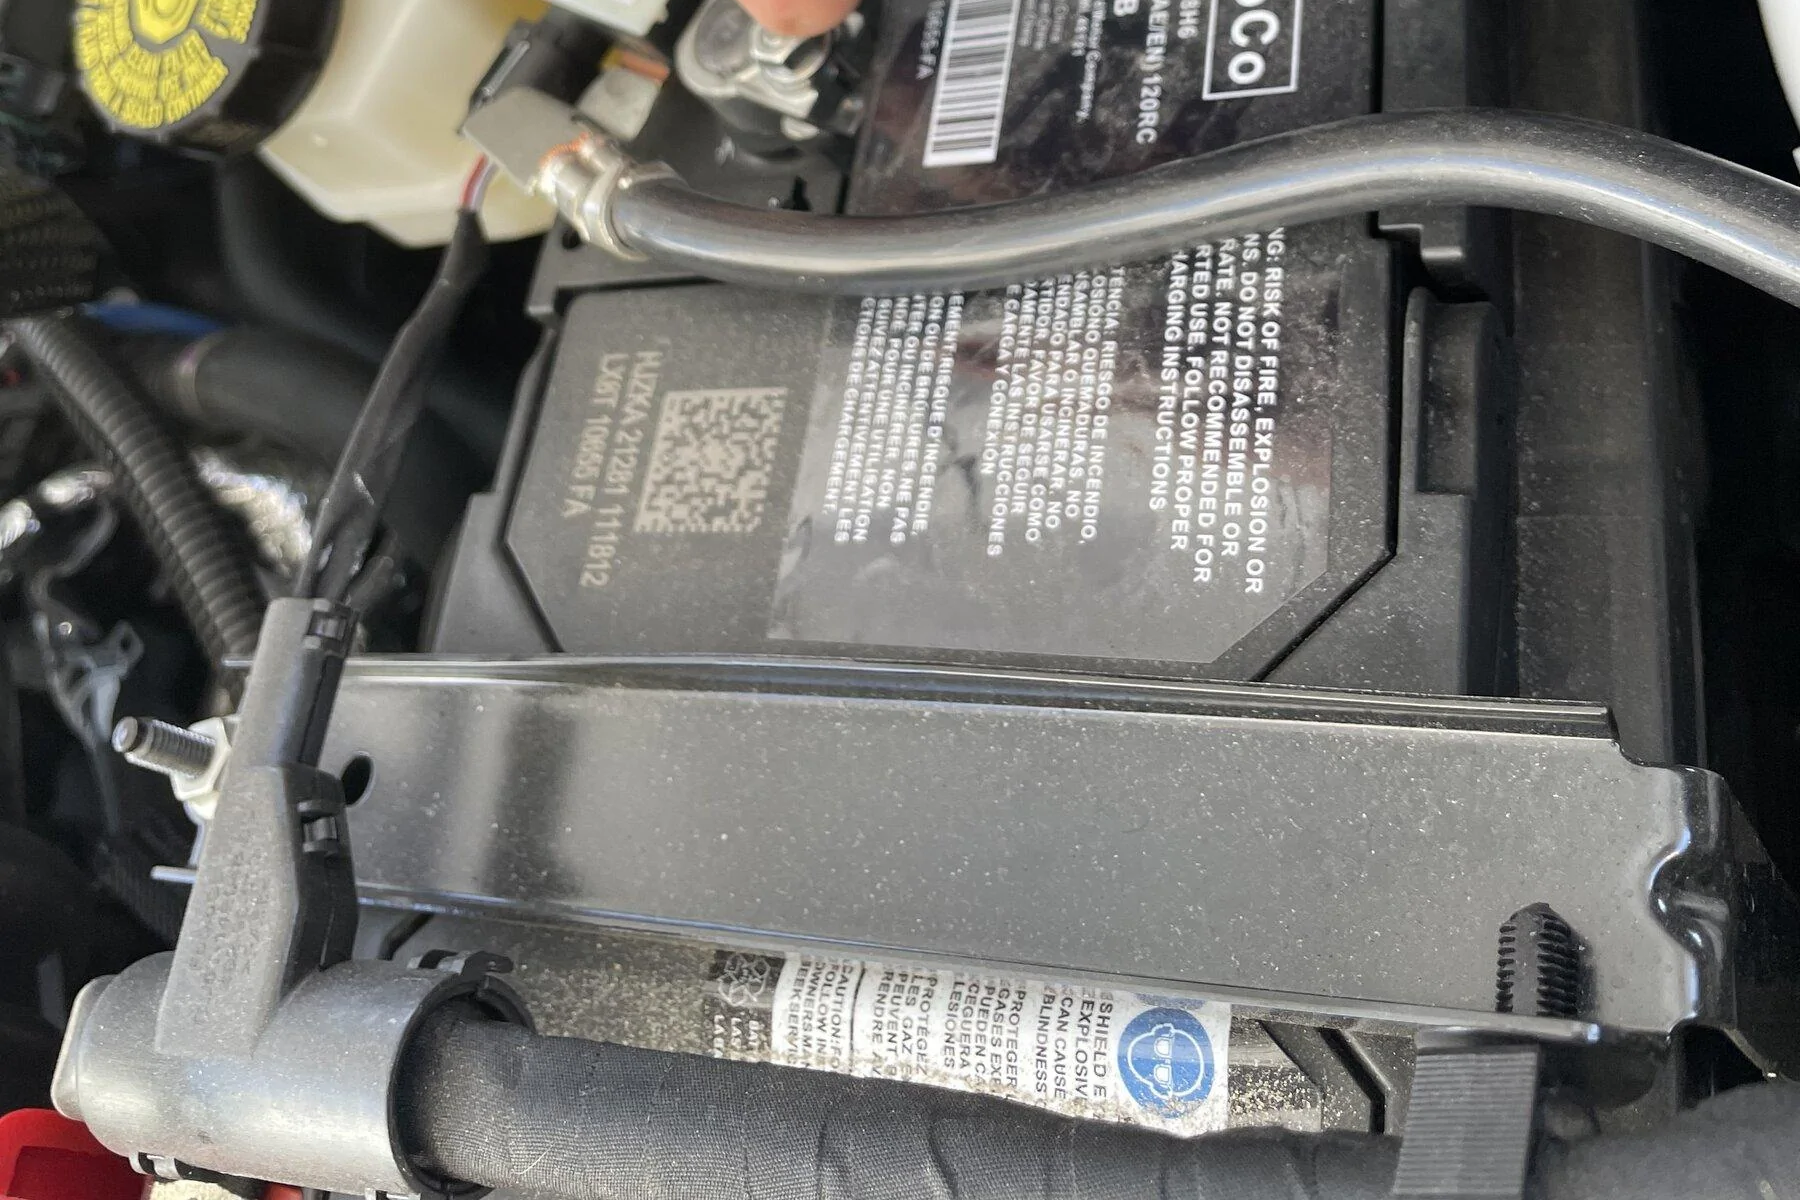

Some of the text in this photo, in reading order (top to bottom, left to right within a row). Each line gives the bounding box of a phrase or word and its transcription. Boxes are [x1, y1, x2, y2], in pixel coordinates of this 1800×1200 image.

[1136, 73, 1162, 144] 120RC
[1239, 272, 1259, 302] DO
[1262, 267, 1284, 317] RISK
[901, 336, 920, 360] OU
[922, 323, 941, 347] OU
[996, 299, 1020, 360] CARGA
[1187, 303, 1209, 351] USE.
[1212, 302, 1233, 345] NOT
[1236, 306, 1257, 350] NOT
[1260, 321, 1281, 350] OF
[846, 361, 864, 386] DE
[880, 338, 902, 385] POUR
[917, 349, 936, 374] DE
[995, 364, 1011, 376] Y
[1008, 363, 1027, 398] LAS
[1025, 349, 1045, 408] FAVOR
[1043, 350, 1064, 399] PARA
[1094, 341, 1118, 410] RIESGO
[1254, 356, 1279, 413] FIRE,
[833, 299, 893, 543] SUIVEZ ATTENTIVEMENT LES
[872, 389, 894, 426] UNE
[1020, 413, 1038, 438] DE
[1068, 348, 1099, 485] QUEMADURAS.
[1091, 415, 1109, 440] DE
[1149, 346, 1184, 510] INSTRUCTIONS
[1180, 356, 1204, 450] FOLLOW
[1033, 403, 1057, 478] USARSE
[1049, 388, 1077, 494] INCINERAR.
[1198, 350, 1229, 528] RECOMMENDED
[1224, 355, 1254, 516] DISASSEMBLE
[579, 351, 664, 587] HJZKA 21281 111812
[852, 430, 886, 542] UTILISATION
[875, 469, 897, 509] NON
[895, 478, 914, 503] NE
[987, 403, 1022, 556] INSTRUCCIONES
[1010, 443, 1034, 514] SEGUIR
[1078, 445, 1105, 544] INCENDIO,
[1247, 418, 1275, 551] EXPLOSION
[560, 484, 597, 519] FA
[889, 507, 910, 544] PAS
[1025, 484, 1047, 541] COMO
[1045, 501, 1063, 529] NO
[1064, 490, 1082, 518] NO
[1170, 455, 1195, 550] PROPER
[1193, 534, 1215, 582] FOR
[1221, 522, 1241, 556] OR
[1245, 559, 1265, 593] OR
[872, 970, 894, 1044] RENDRE
[886, 972, 908, 1055] PEUVENT
[904, 974, 924, 1007] LES
[989, 988, 1010, 1048] GASES
[901, 1016, 914, 1055] GAZ
[943, 981, 965, 1068] LESIONES
[959, 983, 980, 1069] CEGUERA
[974, 985, 996, 1057] PUEDEN
[1006, 990, 1026, 1088] PROTEGER
[1035, 993, 1056, 1093] BLINDNESS
[1053, 996, 1073, 1100] CAN CAUSE
[1075, 1000, 1095, 1100] EXPLOSIV
[1093, 1002, 1113, 1077] SHIELD
